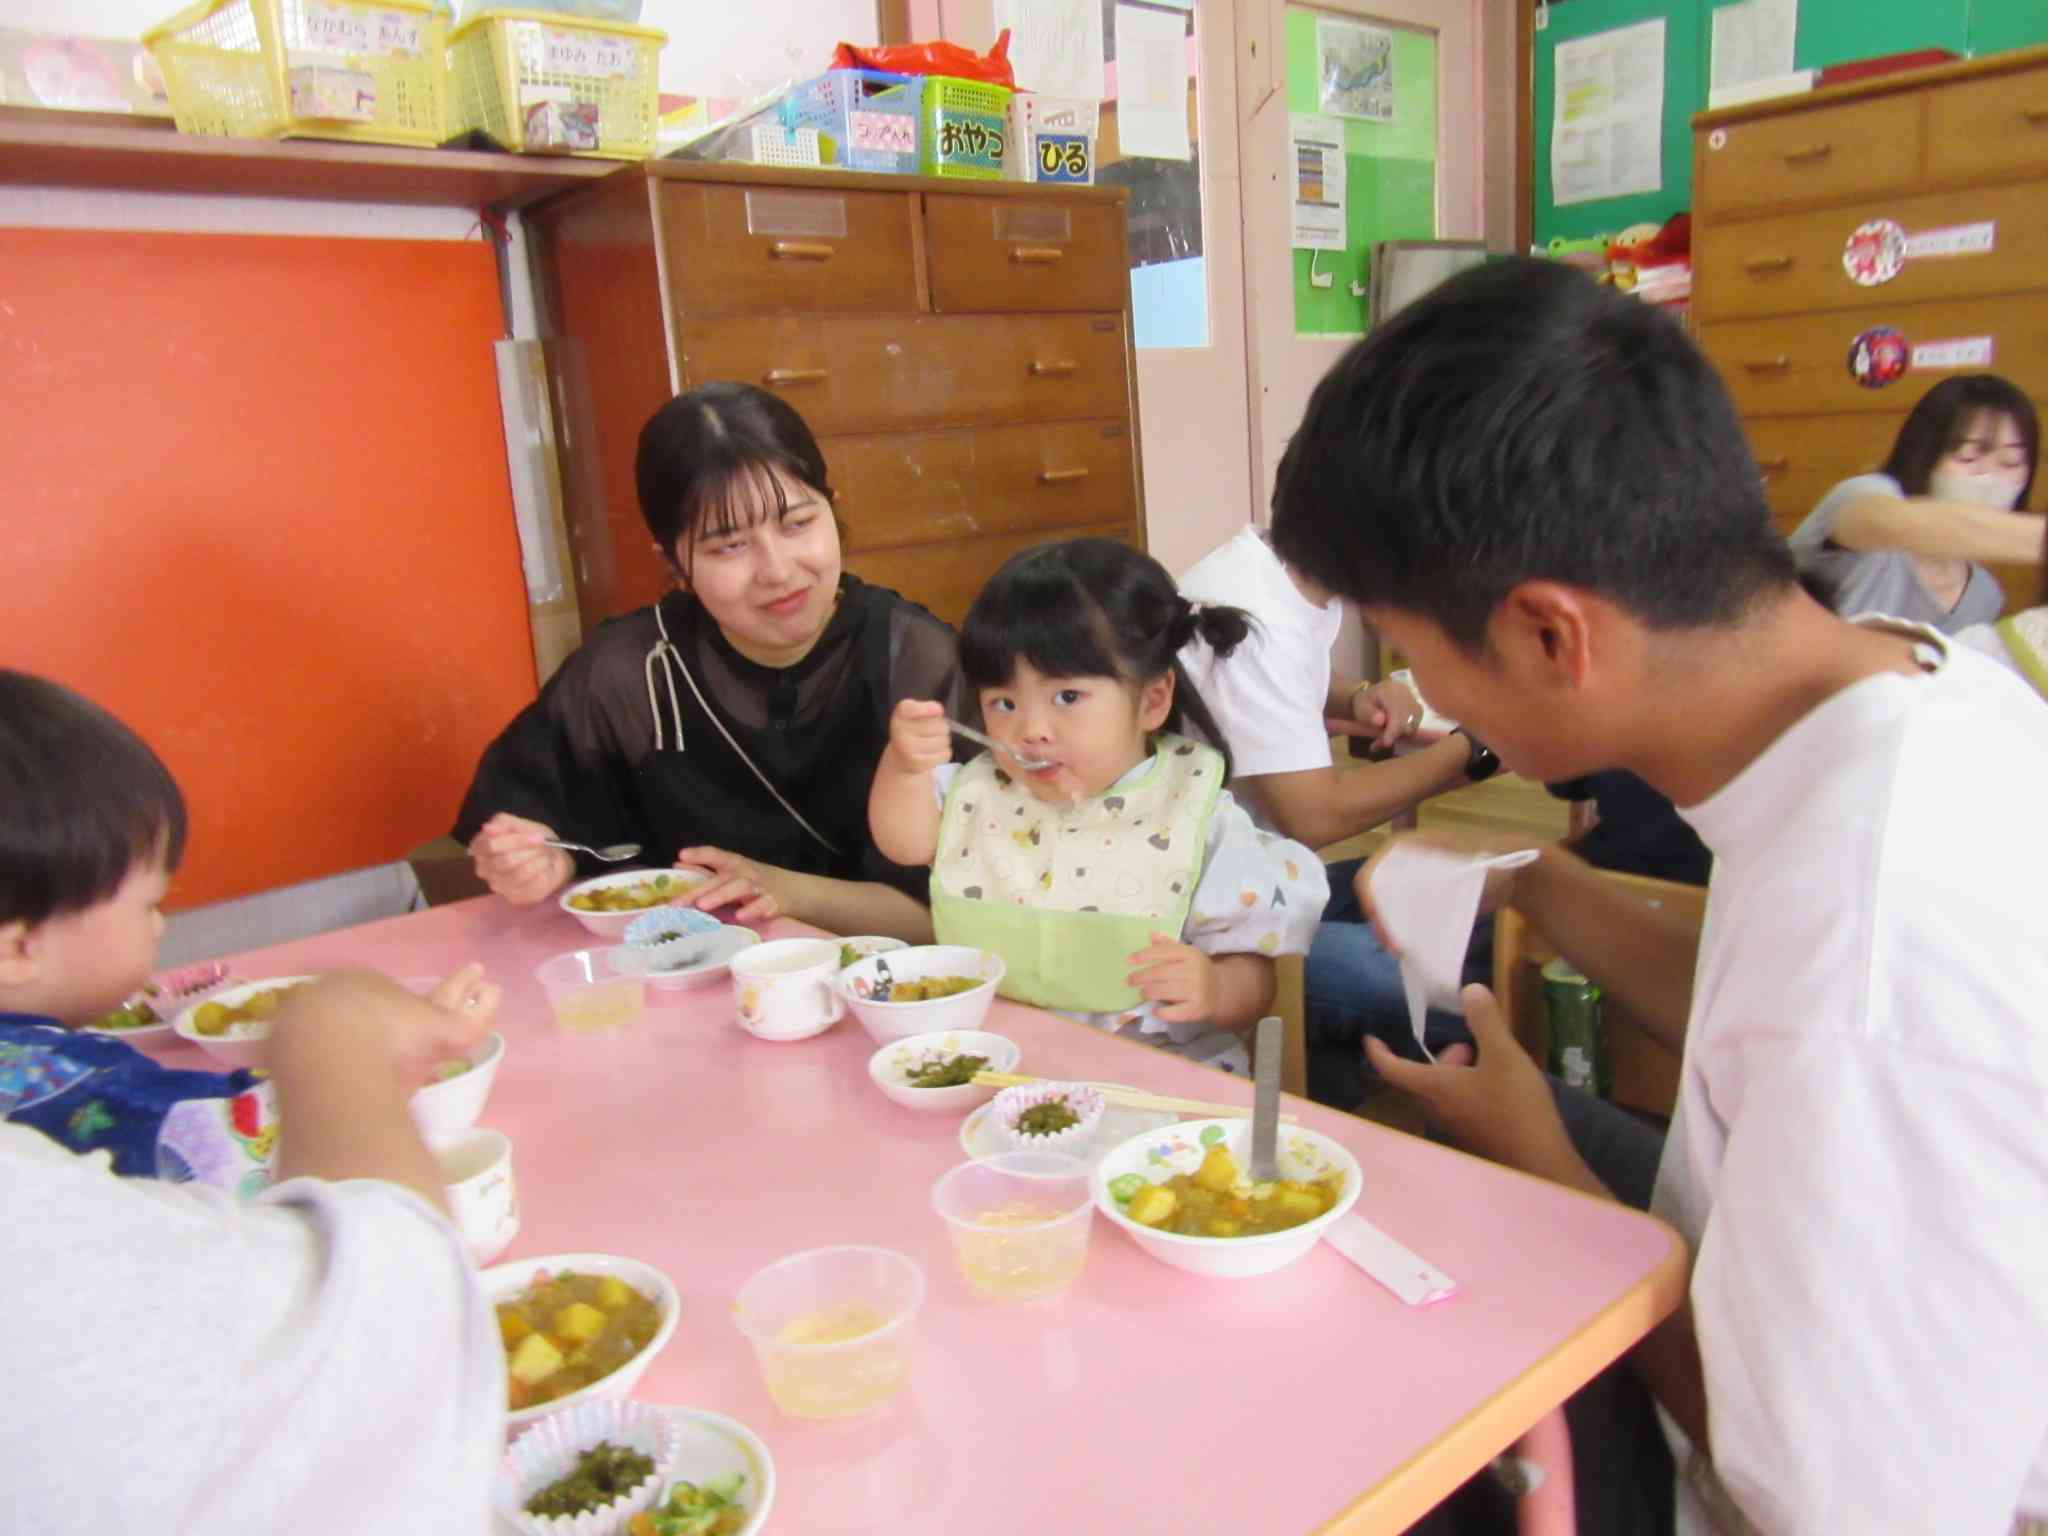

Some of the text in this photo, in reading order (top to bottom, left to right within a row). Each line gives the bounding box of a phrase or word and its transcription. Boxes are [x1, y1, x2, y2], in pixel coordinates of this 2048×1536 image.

[939, 119, 1004, 160] おやつ
[1039, 139, 1088, 175] ひる
